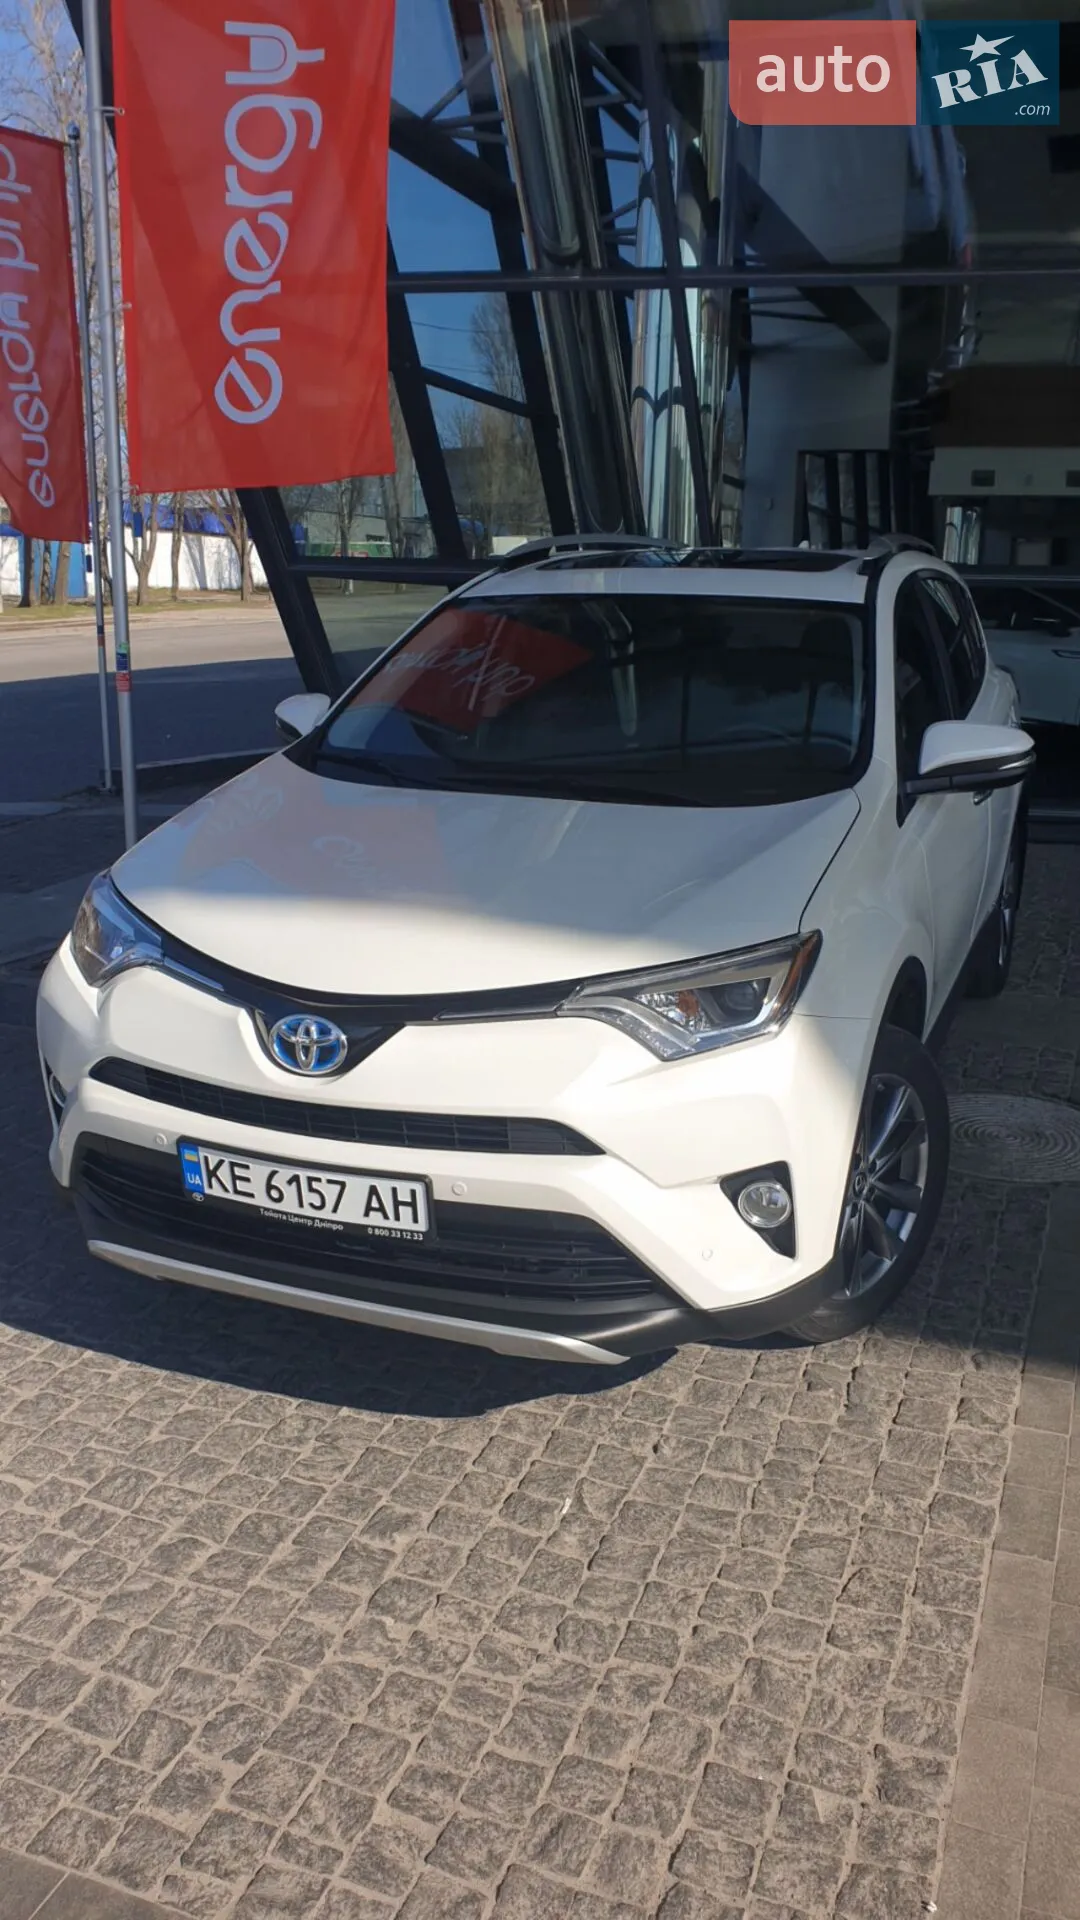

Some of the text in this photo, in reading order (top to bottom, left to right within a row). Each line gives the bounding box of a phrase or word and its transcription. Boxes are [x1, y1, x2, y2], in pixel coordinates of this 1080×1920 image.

[214, 21, 325, 425] energy
[187, 1173, 202, 1186] UA
[203, 1155, 419, 1224] KE 6157 AH
